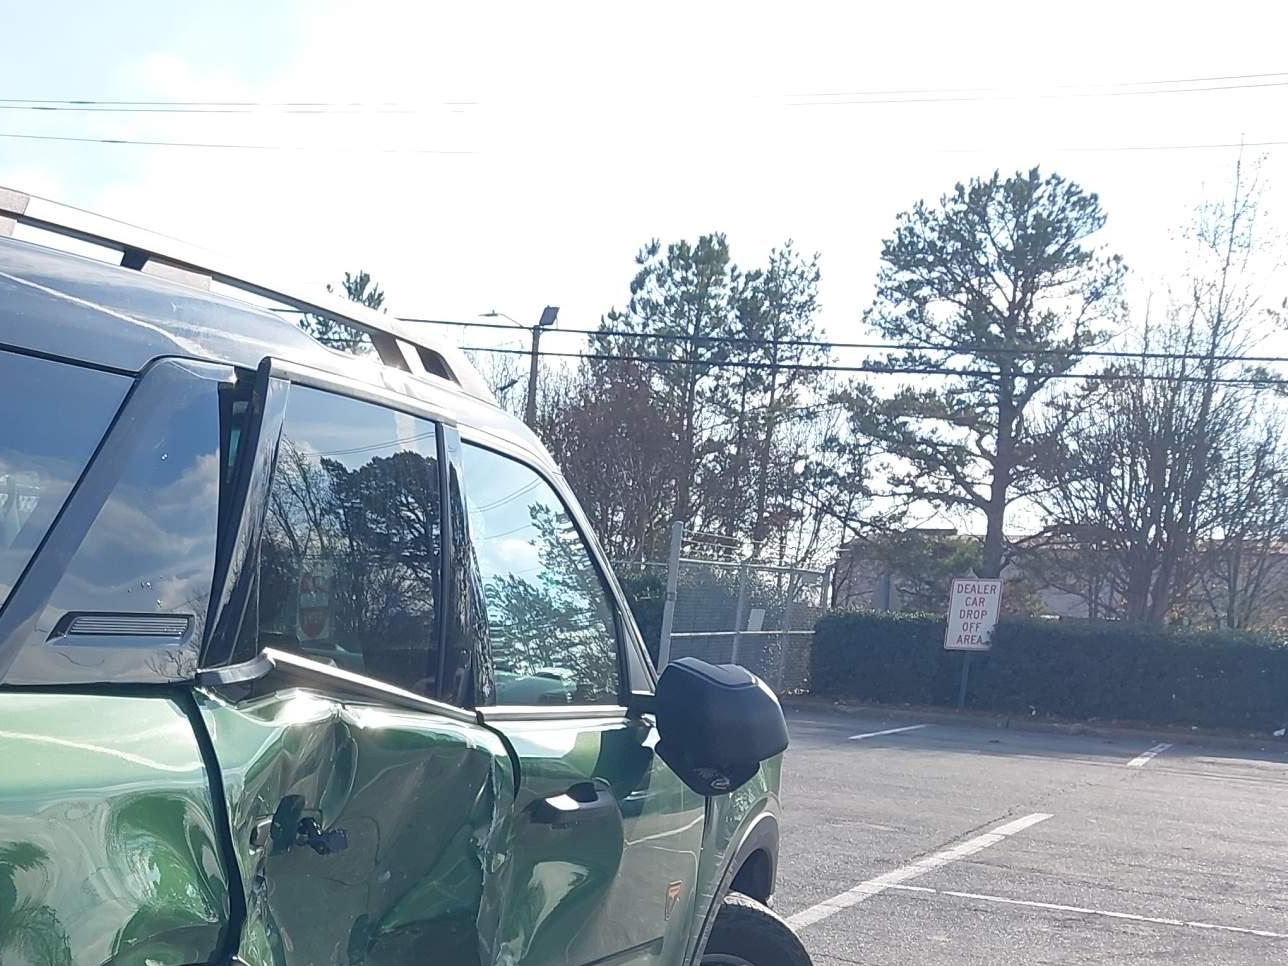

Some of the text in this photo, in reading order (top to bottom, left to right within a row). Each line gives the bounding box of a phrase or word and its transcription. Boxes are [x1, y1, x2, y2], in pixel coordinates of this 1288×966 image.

[957, 583, 997, 595] DEALER
[965, 596, 986, 607] CAR
[959, 609, 988, 620] DROP
[962, 622, 982, 632] OFF
[956, 634, 984, 646] AREA
